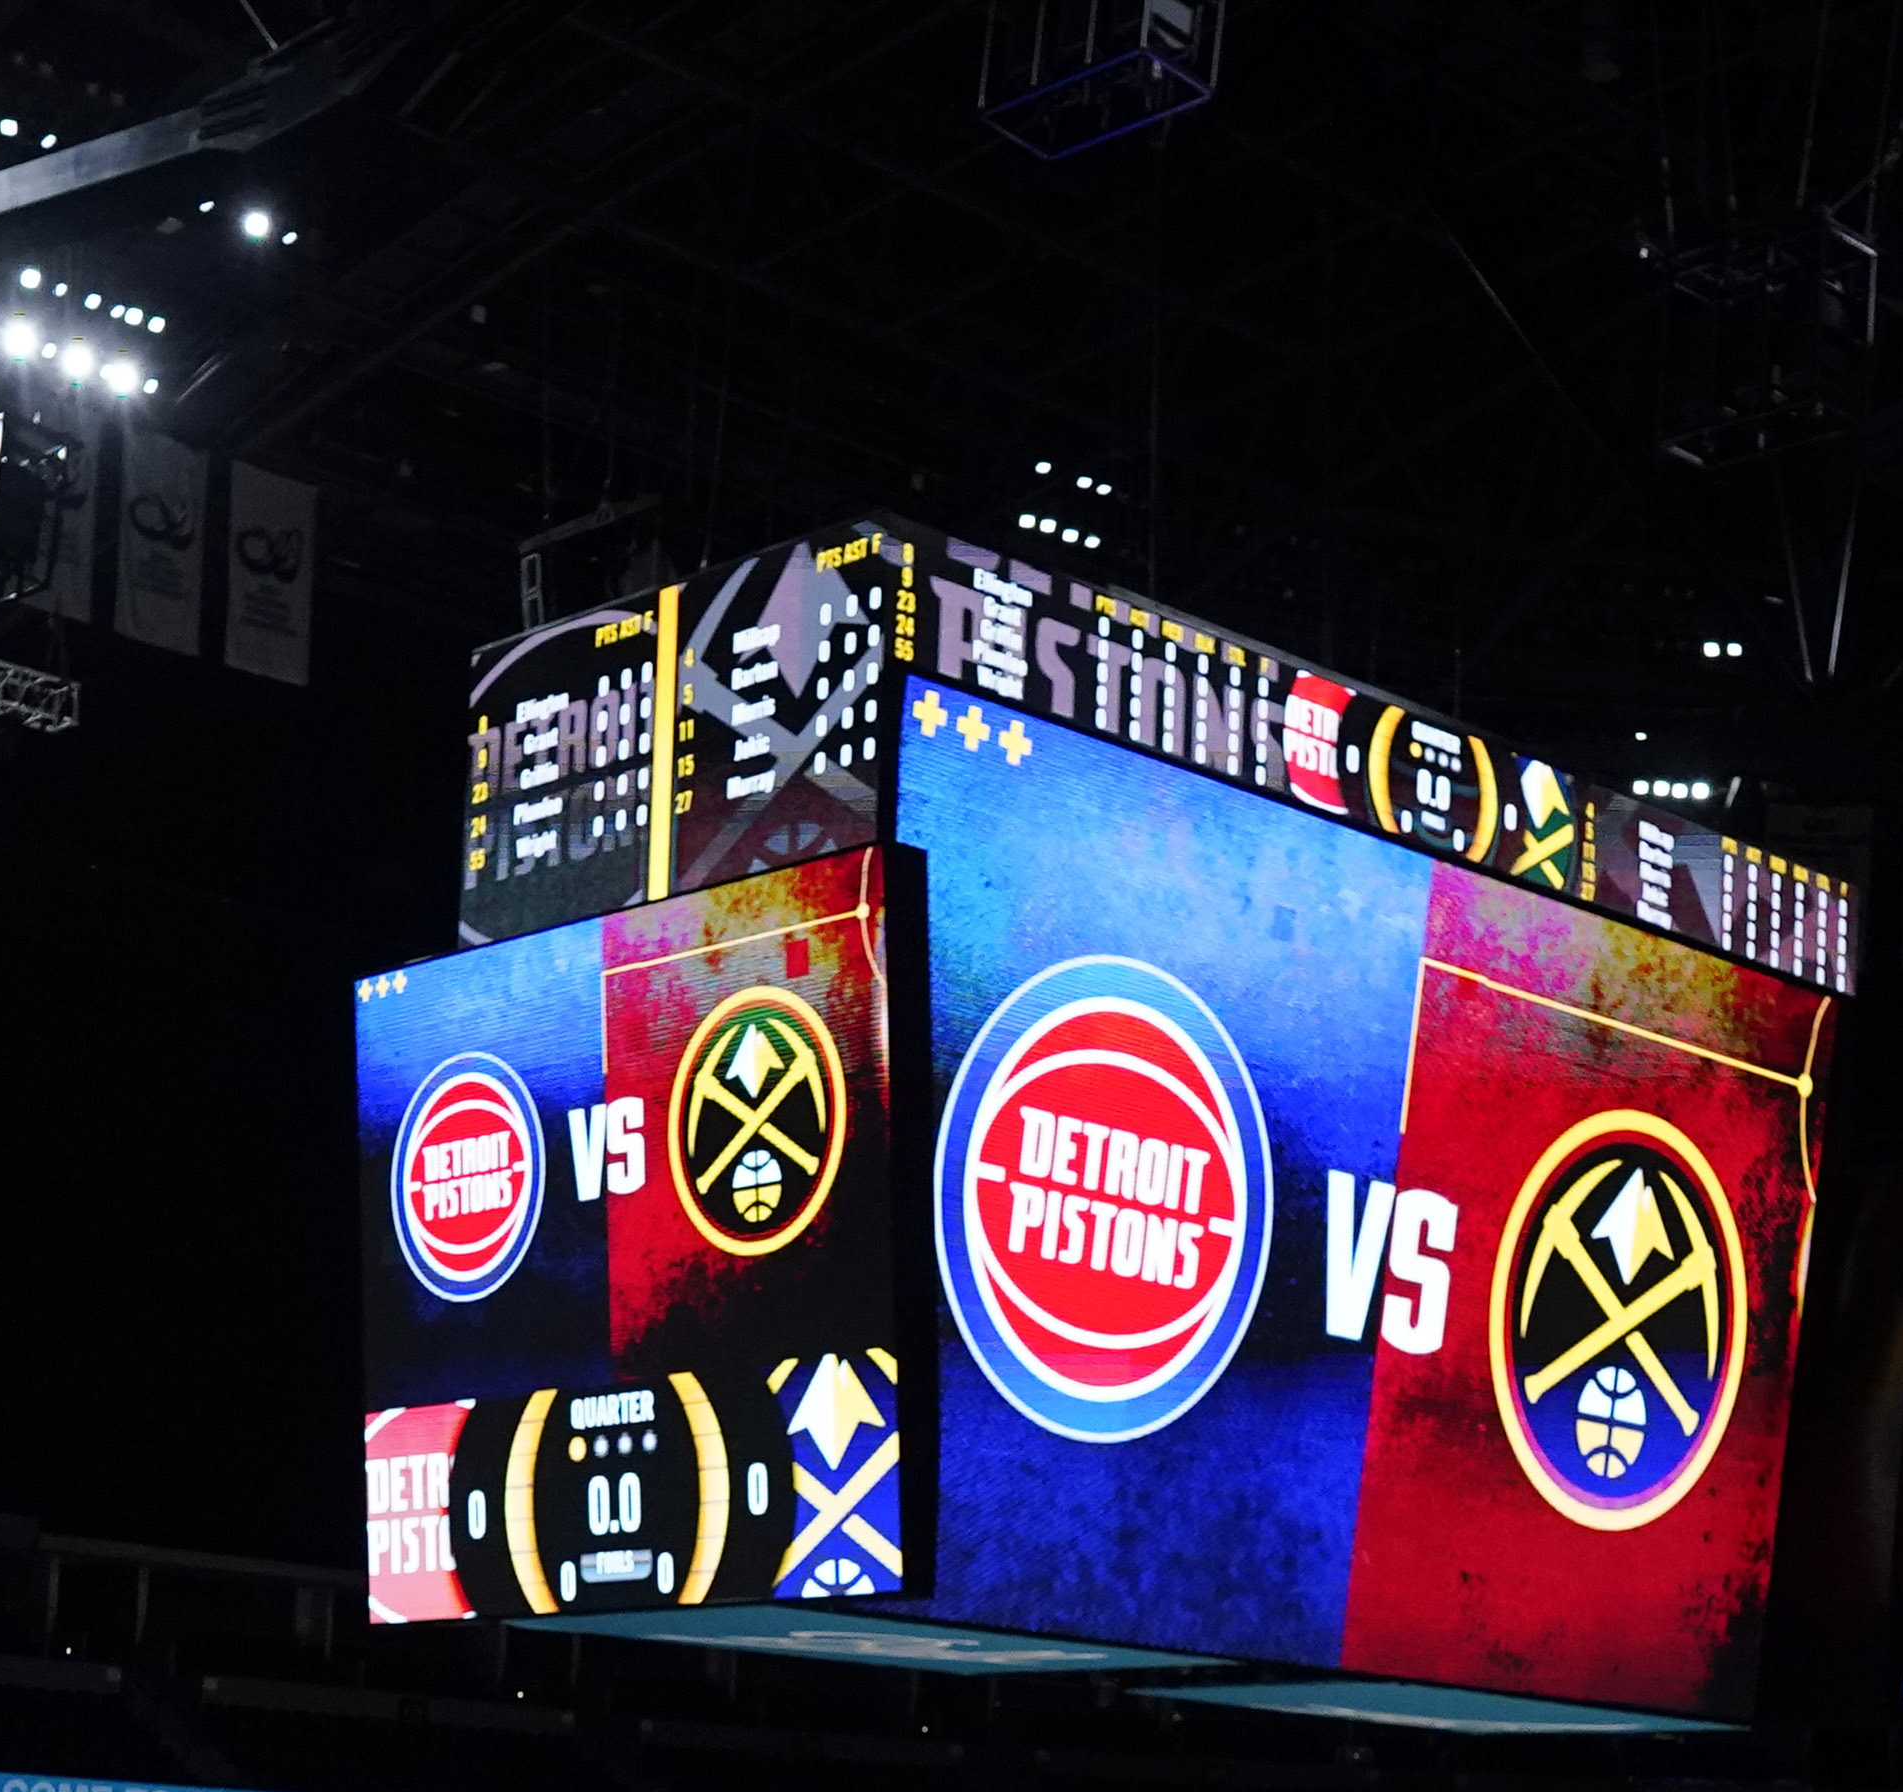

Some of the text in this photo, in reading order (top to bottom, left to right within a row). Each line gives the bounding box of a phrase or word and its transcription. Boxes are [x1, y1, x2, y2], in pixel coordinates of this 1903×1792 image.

[871, 533, 883, 555] F
[896, 614, 915, 637] 24
[897, 590, 916, 614] 23
[679, 720, 695, 741] 11
[678, 755, 695, 777] 15
[471, 782, 489, 804] 23
[675, 790, 693, 814] 27
[470, 816, 487, 837] 24
[422, 1130, 511, 1183] DETROIT
[568, 1097, 646, 1201] VS
[1019, 1106, 1209, 1215] DETROIT
[423, 1170, 513, 1222] PISTONS
[1008, 1180, 1199, 1290] PISTONS
[1326, 1170, 1459, 1355] VS
[570, 1390, 655, 1430] QUARTER
[588, 1472, 642, 1536] 0.0
[747, 1462, 768, 1515] 0
[468, 1490, 487, 1539] 0
[560, 1560, 577, 1601] 0
[657, 1552, 674, 1594] 0
